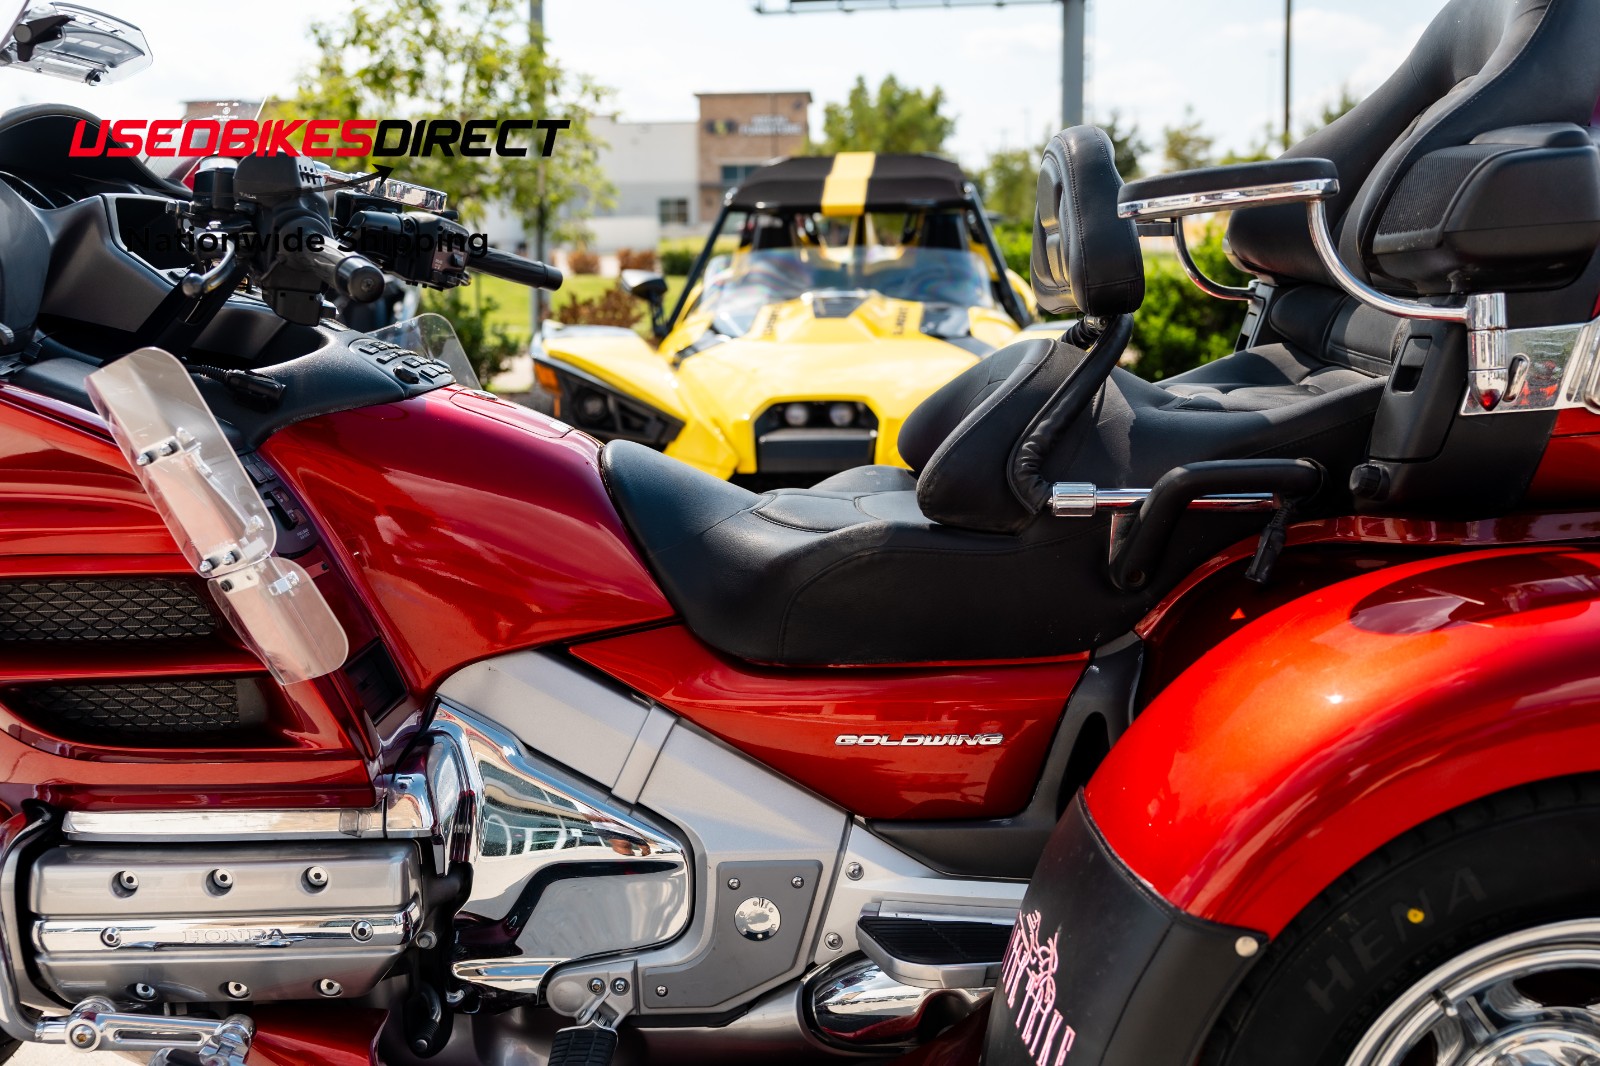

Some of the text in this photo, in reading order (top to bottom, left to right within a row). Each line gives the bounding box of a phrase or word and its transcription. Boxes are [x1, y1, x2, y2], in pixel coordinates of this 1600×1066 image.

[834, 733, 1004, 746] GOLDWING
[182, 928, 290, 943] HONDA
[1015, 969, 1077, 1066] TRIKE
